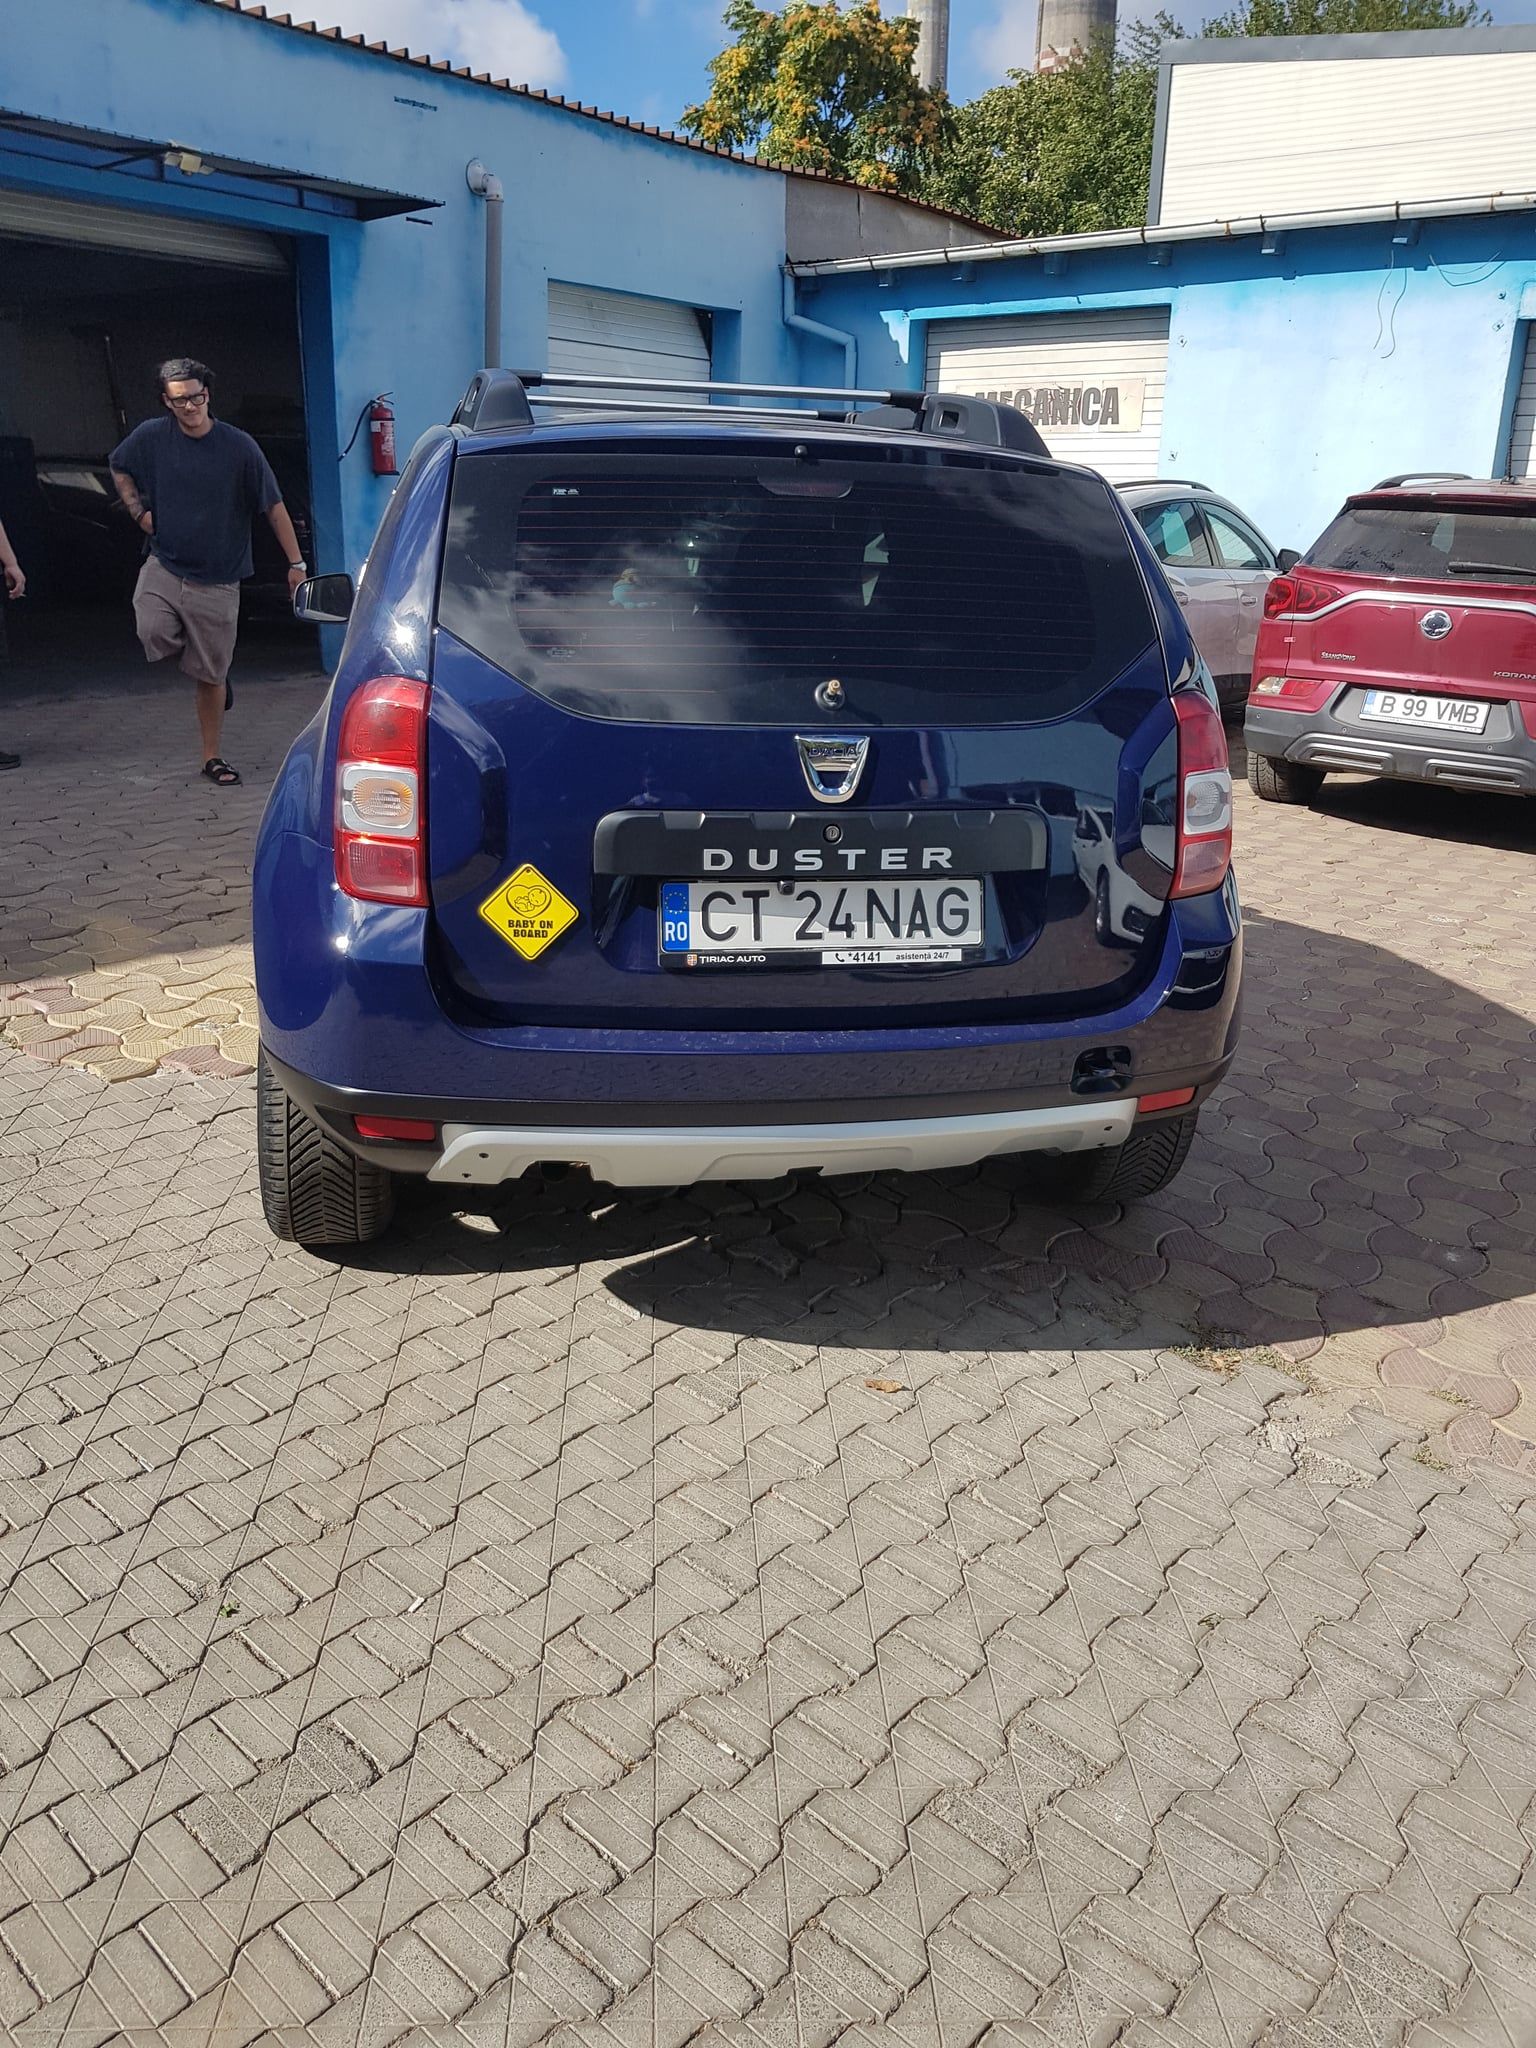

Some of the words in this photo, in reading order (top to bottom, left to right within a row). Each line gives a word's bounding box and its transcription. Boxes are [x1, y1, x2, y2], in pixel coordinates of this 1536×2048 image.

[975, 387, 1120, 426] CANICA
[1380, 695, 1396, 713] B
[1402, 699, 1428, 717] 99
[1437, 701, 1480, 724] VMB
[808, 747, 858, 757] DACIA
[703, 848, 953, 871] DUSTER
[701, 890, 770, 942] CT
[508, 919, 536, 928] BABY
[540, 920, 554, 929] ON
[665, 921, 688, 942] RO
[513, 929, 548, 938] BOARD
[736, 955, 767, 963] AUTO
[933, 951, 950, 960] 24/7
